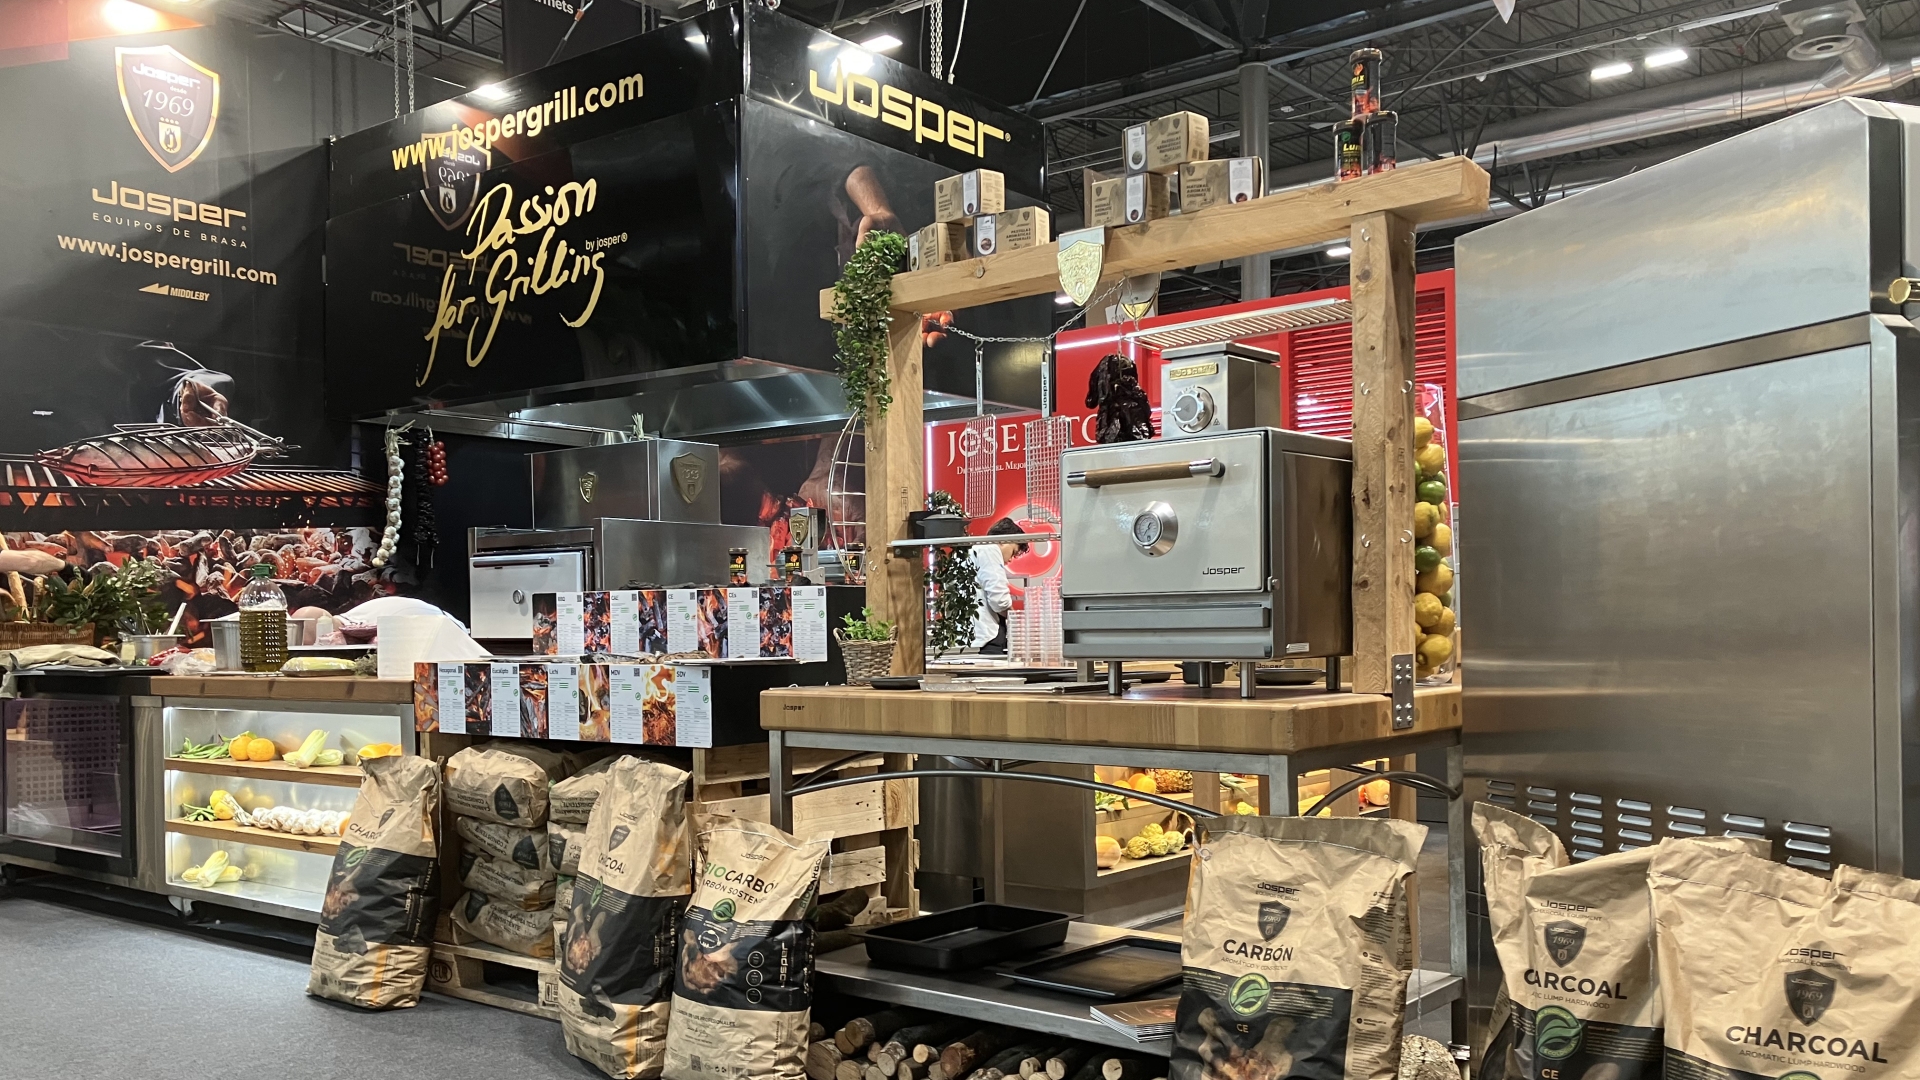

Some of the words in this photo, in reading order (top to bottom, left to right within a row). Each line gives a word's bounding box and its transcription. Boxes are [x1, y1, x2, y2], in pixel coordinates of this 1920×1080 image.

[143, 89, 195, 117] 1969
[391, 73, 644, 170] www.jospergrill.com
[92, 180, 247, 228] Josper
[93, 212, 162, 232] EQUIPOS
[173, 227, 191, 238] DE
[201, 233, 248, 249] BRASA
[585, 238, 595, 251] by
[57, 234, 277, 285] www.jospergrill.com
[170, 287, 210, 301] MIDDLEBY
[1202, 566, 1245, 576] Josper
[1257, 882, 1301, 895] Josper
[1541, 900, 1595, 912] Josper
[1553, 936, 1575, 946] 1969
[1223, 938, 1293, 961] CARBÓN
[1796, 990, 1823, 1001] 1969
[1565, 997, 1610, 1010] HARDWOOD
[1236, 1023, 1249, 1033] CE
[1725, 1026, 1888, 1064] CHARCOAL
[1739, 1049, 1786, 1063] AROMATIC
[1788, 1057, 1812, 1066] LUMP
[1814, 1061, 1866, 1073] HARDWOOD
[1541, 1068, 1560, 1080] CE
